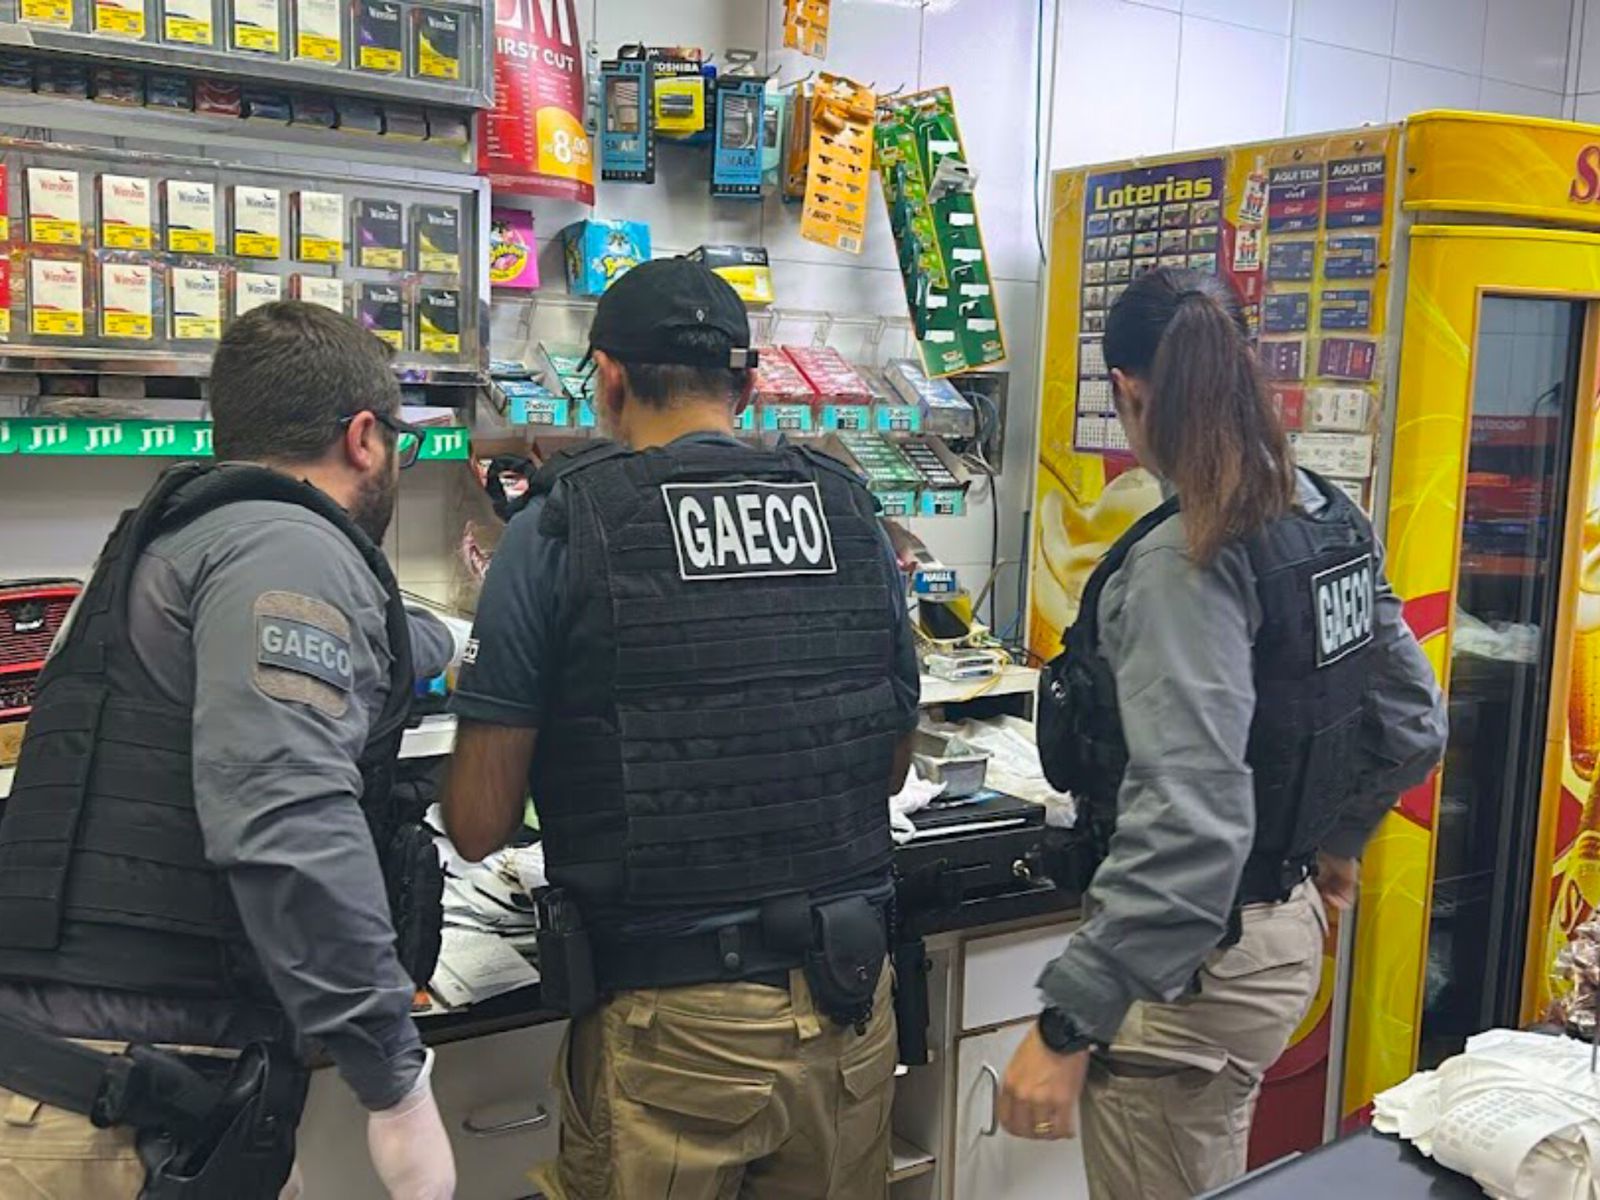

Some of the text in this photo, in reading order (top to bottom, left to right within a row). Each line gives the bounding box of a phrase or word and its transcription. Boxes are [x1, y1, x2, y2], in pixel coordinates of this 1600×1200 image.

[368, 6, 397, 21] Winston
[427, 16, 456, 31] Winston
[496, 37, 575, 73] IRST CUT
[1569, 144, 1600, 203] S
[39, 178, 74, 193] Winston
[112, 184, 146, 199] Winston
[1095, 175, 1213, 210] Loterias
[177, 190, 210, 205] Winston
[245, 195, 276, 209] Winston
[369, 207, 399, 220] Winston
[427, 212, 455, 226] Winston
[43, 269, 77, 284] Winston
[114, 271, 146, 286] Winston
[185, 278, 216, 292] Winston
[246, 282, 277, 296] Winston
[370, 289, 399, 301] Winston
[428, 293, 456, 307] Winston
[678, 494, 824, 569] GAECO
[1318, 567, 1373, 655] GAECO
[261, 625, 351, 677] GAECO
